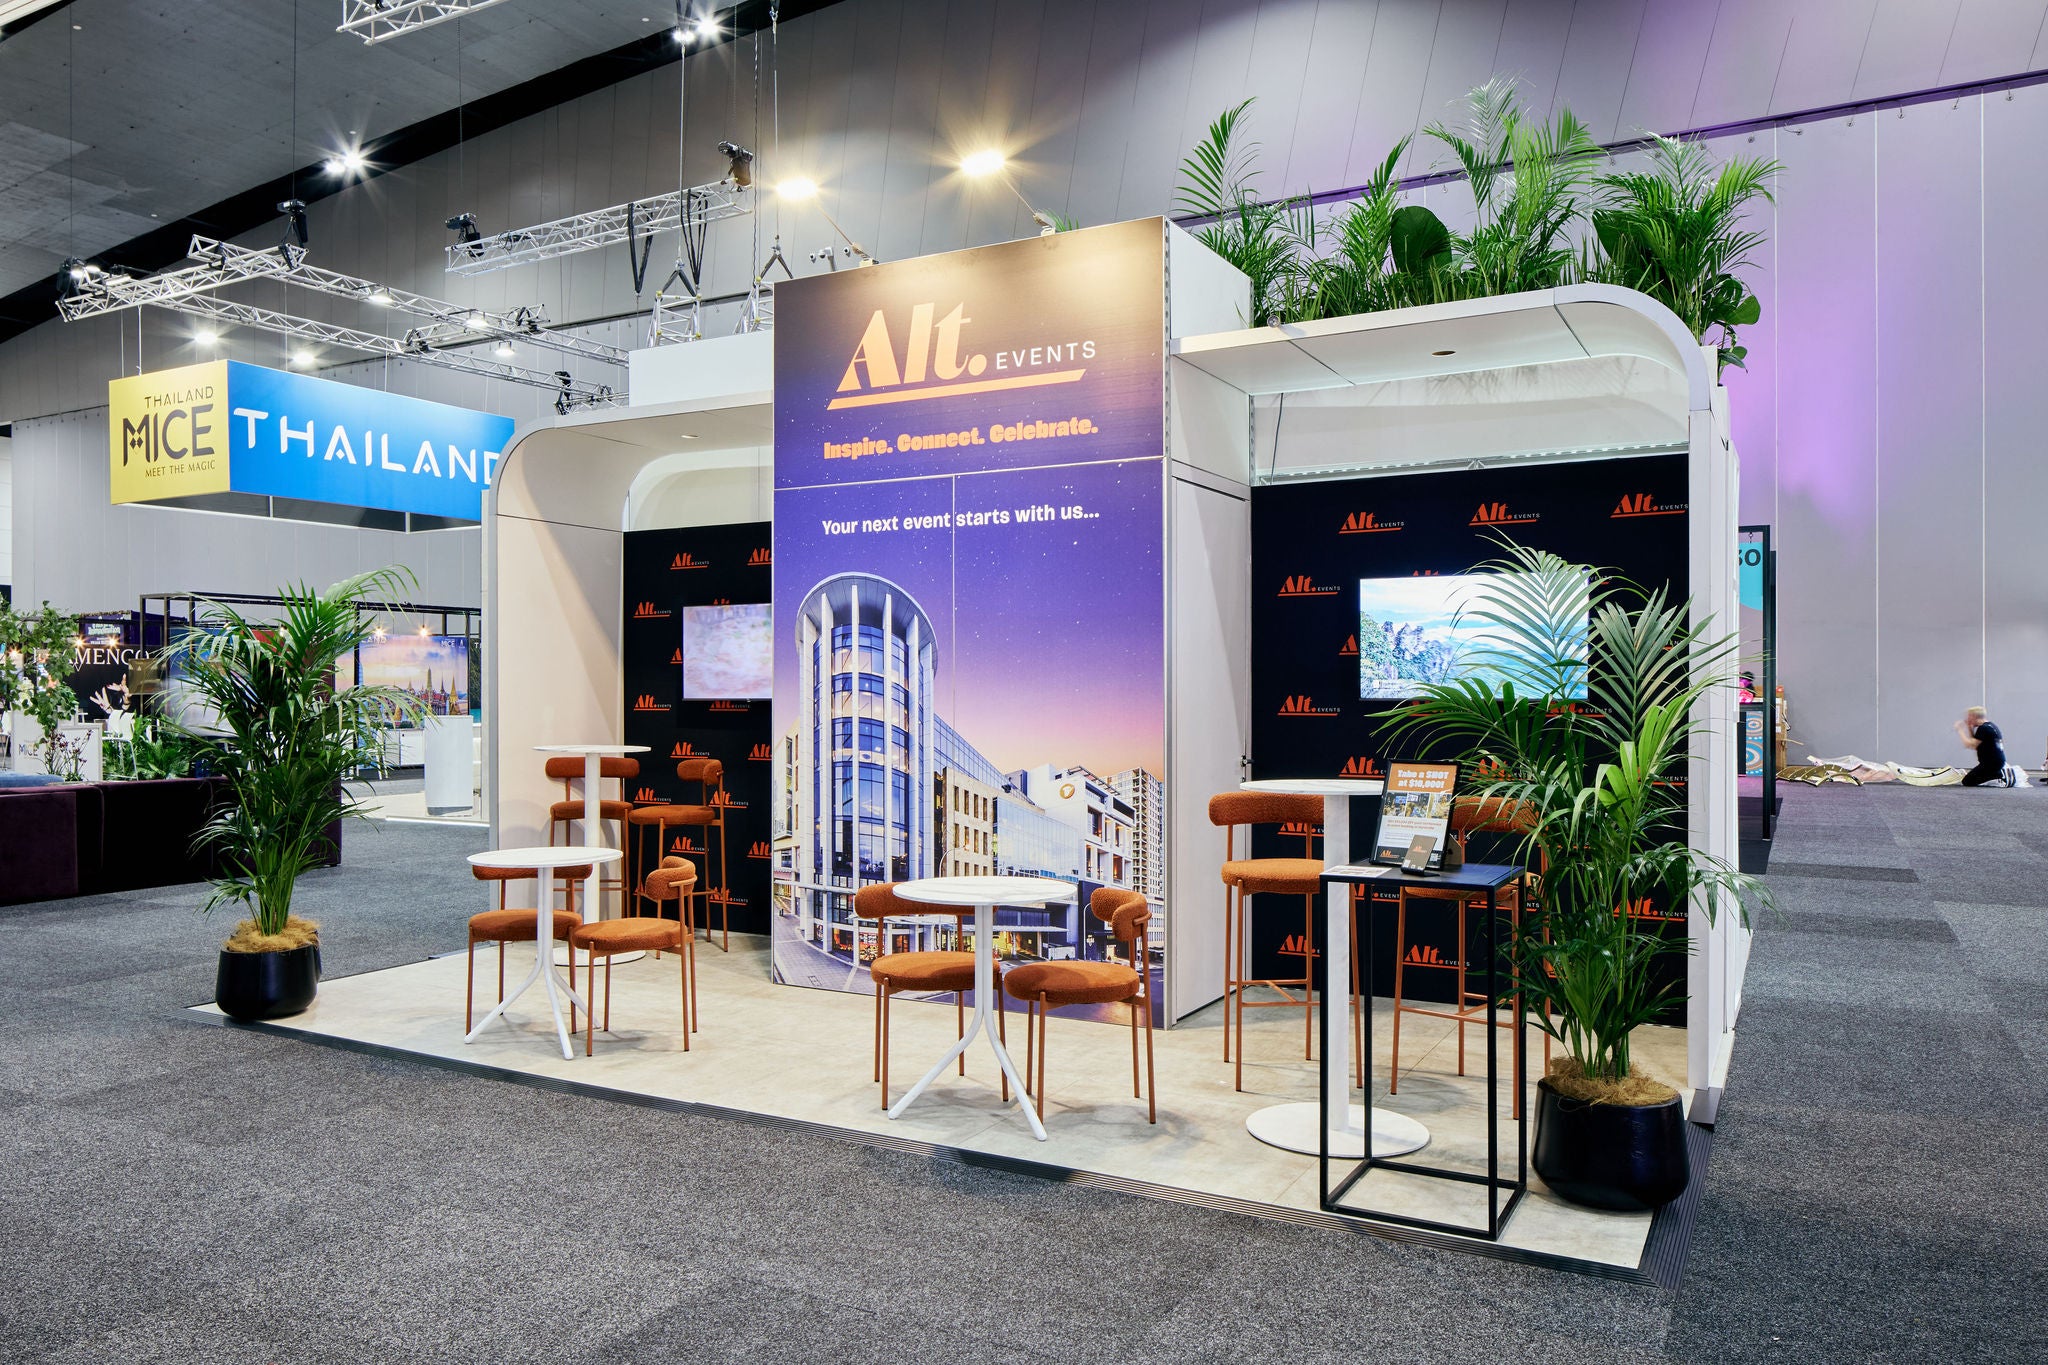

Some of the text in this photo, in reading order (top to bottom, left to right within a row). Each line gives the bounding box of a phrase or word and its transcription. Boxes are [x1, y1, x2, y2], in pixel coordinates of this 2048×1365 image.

[835, 301, 1097, 393] Alt. EVENTS
[145, 386, 214, 408] THAILAND
[122, 403, 216, 468] MICE
[824, 416, 1099, 460] Inspire. Connect. Celebrate.
[145, 459, 216, 478] MEET THE MAGIC
[1471, 502, 1513, 521] Alt.
[1613, 492, 1688, 513] Alt. EVENTS
[821, 504, 1100, 535] Your next event starts with us...
[1340, 511, 1380, 530] Alt.
[671, 552, 695, 567] Alt.
[1279, 575, 1317, 593] Alt.
[634, 601, 657, 616] Alt.
[634, 694, 657, 709] Alt.
[1279, 694, 1317, 713] Alt.
[671, 741, 695, 756] Alt.
[1341, 755, 1380, 775] Alt.
[634, 786, 657, 802] Alt.
[671, 836, 696, 851] Alt.
[1379, 891, 1400, 899] EVENT
[1404, 944, 1444, 965] Alt.
